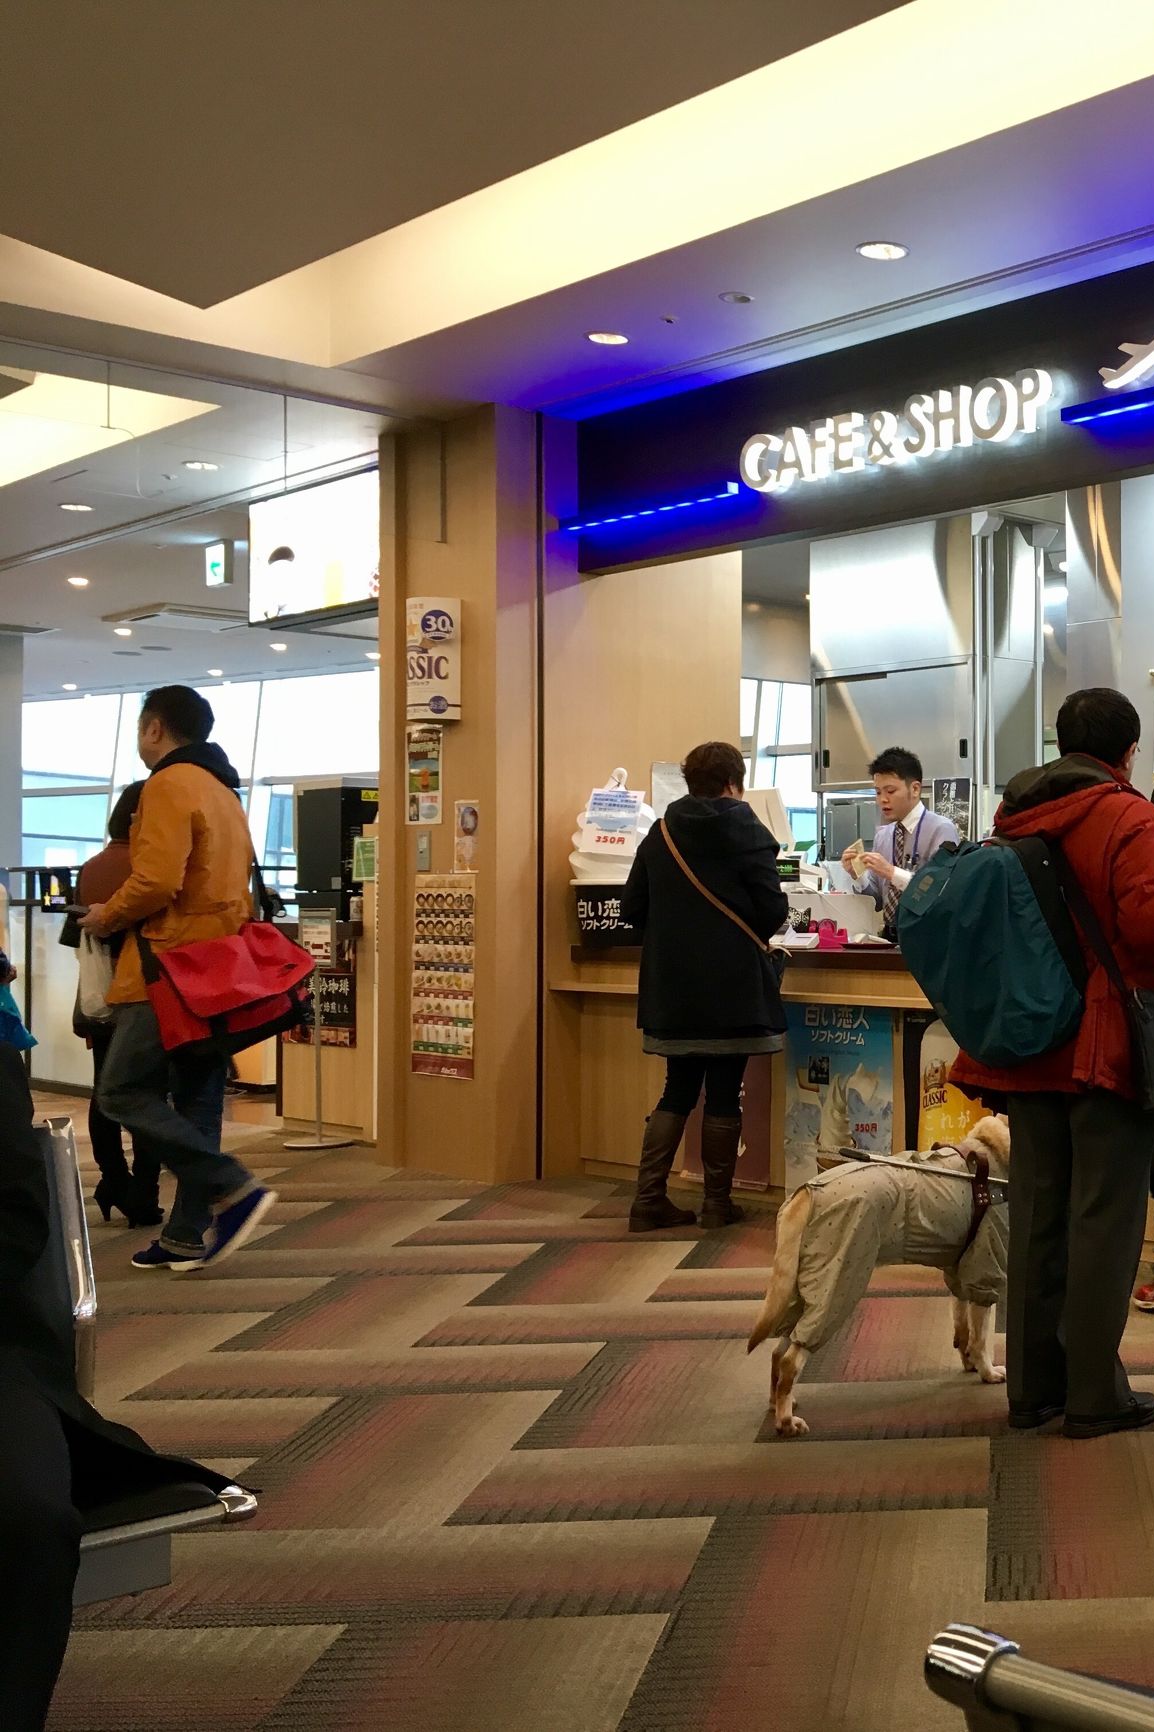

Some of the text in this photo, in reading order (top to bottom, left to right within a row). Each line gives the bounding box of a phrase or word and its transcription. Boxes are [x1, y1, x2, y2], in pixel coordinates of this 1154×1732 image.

[805, 1006, 870, 1030] 白い恋人
[811, 1029, 865, 1046] ソフトクリーム
[922, 1089, 948, 1109] CLASSIC
[854, 1122, 878, 1133] 350円
